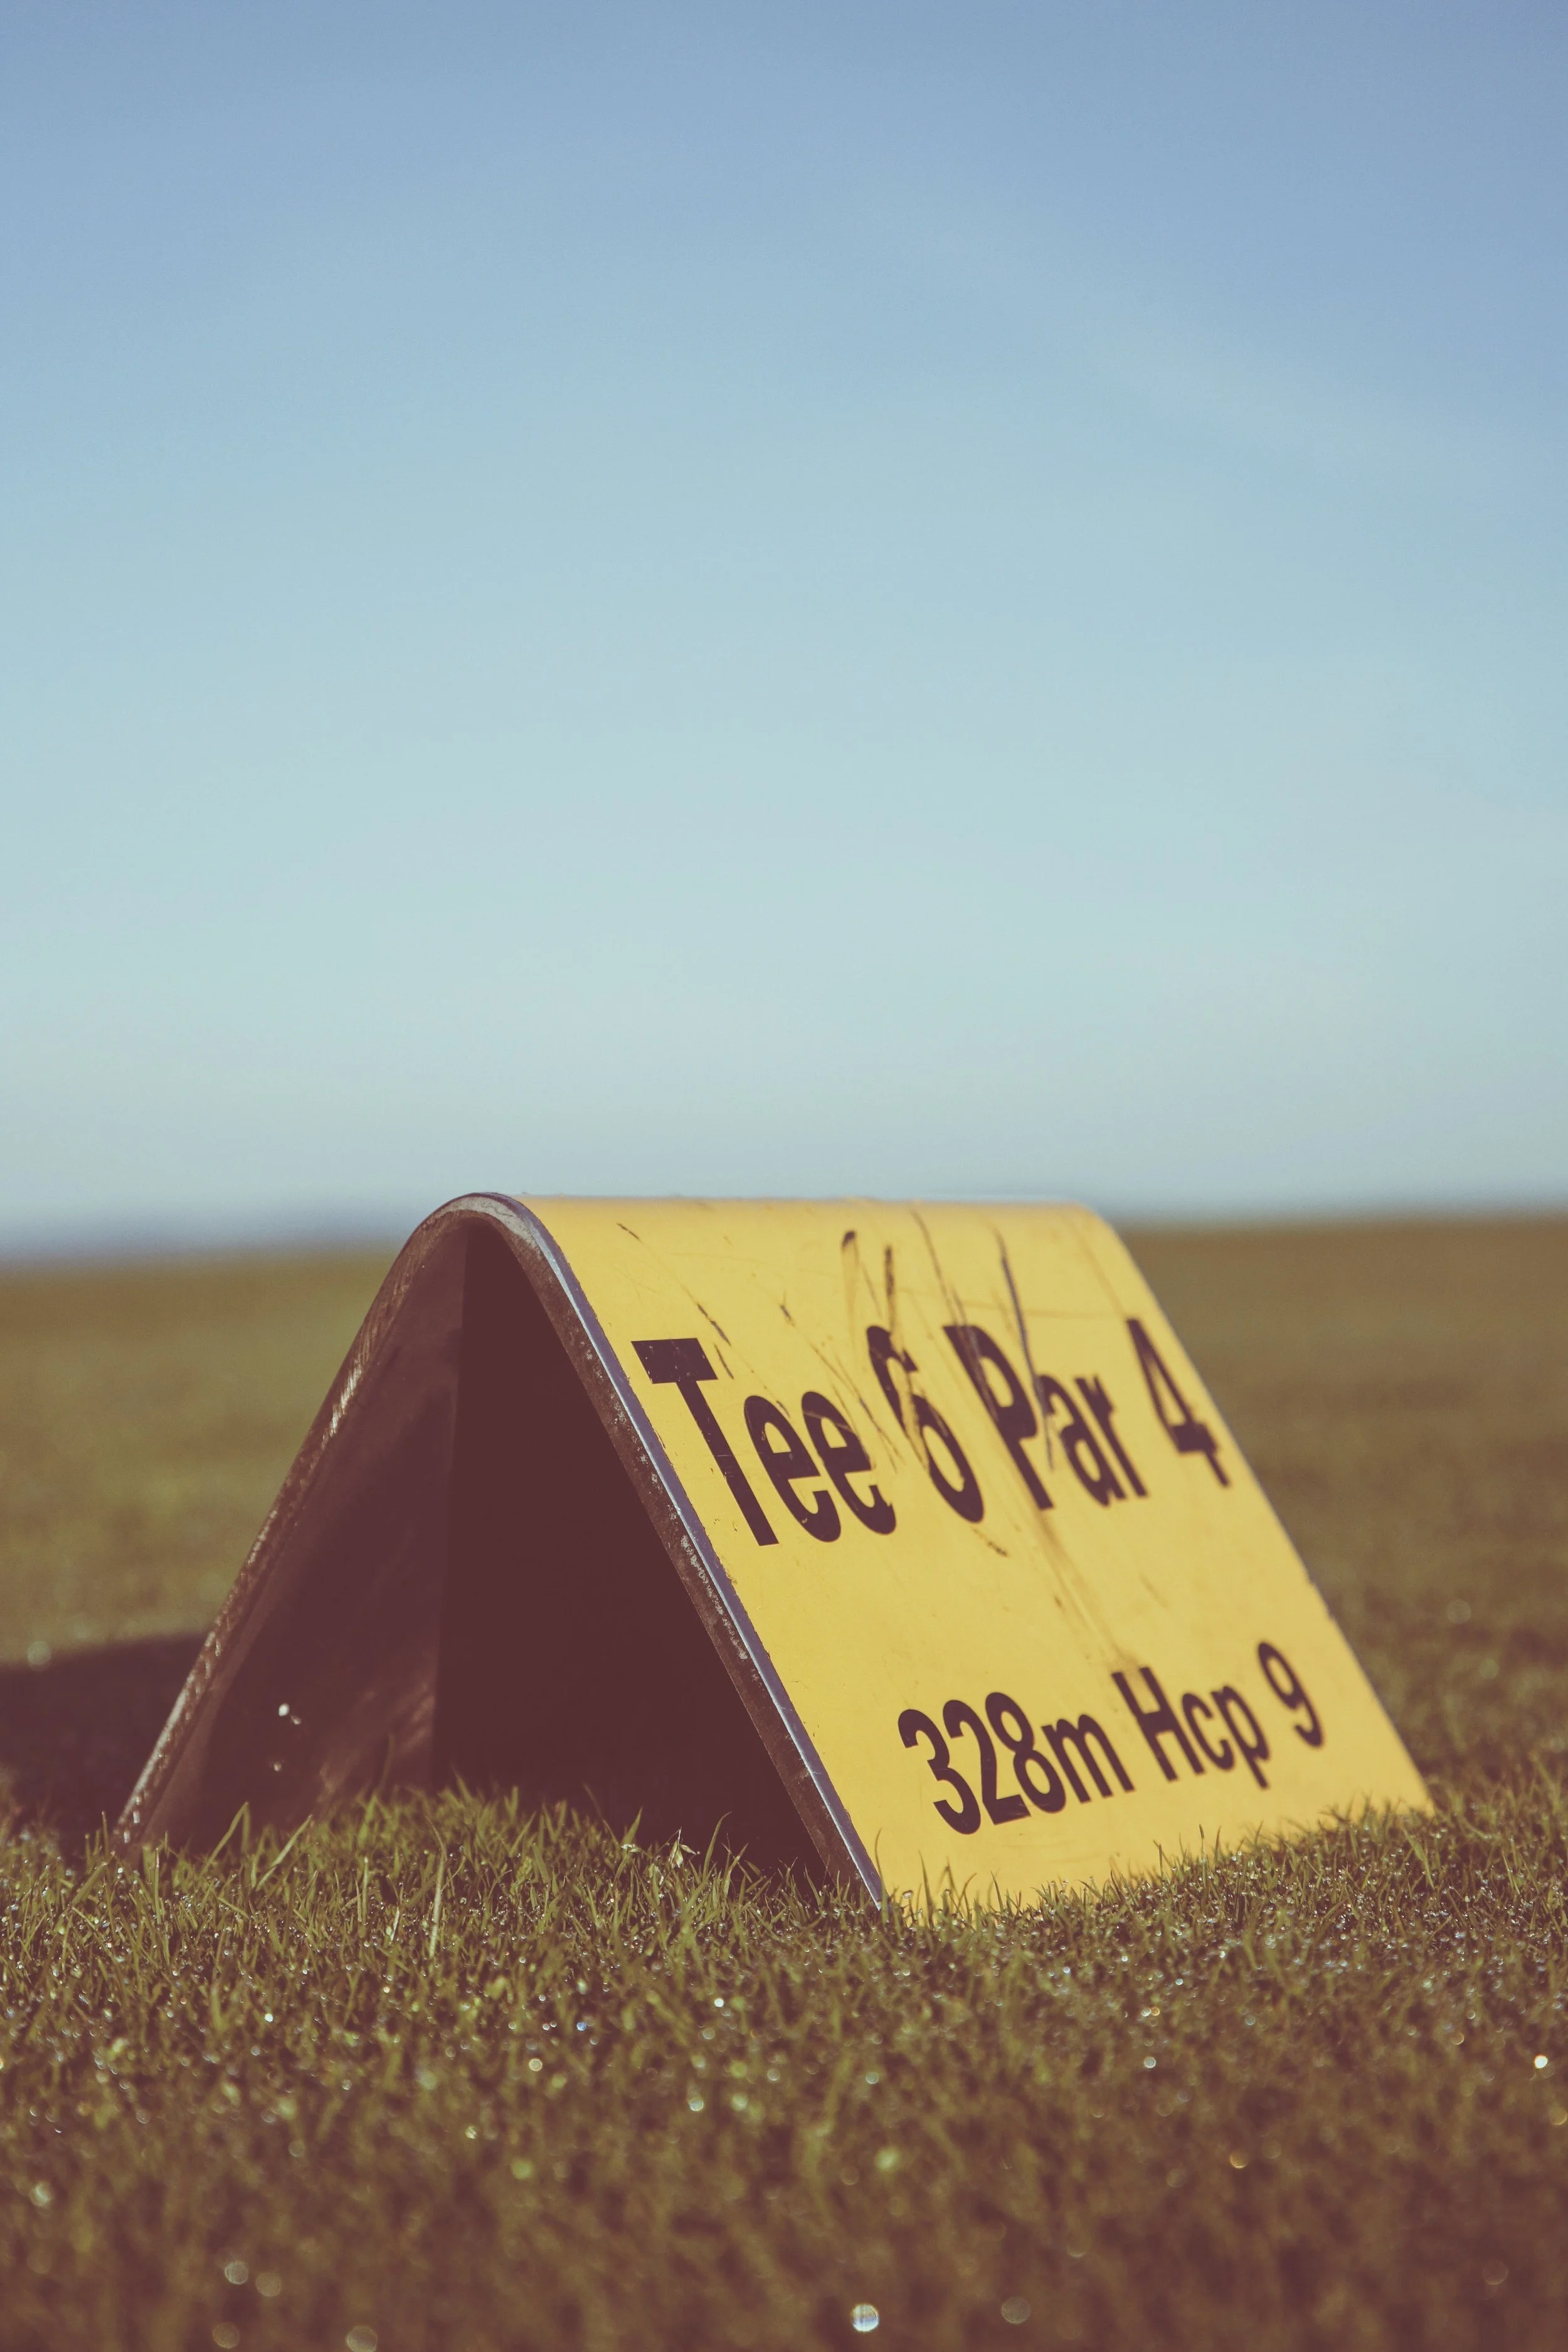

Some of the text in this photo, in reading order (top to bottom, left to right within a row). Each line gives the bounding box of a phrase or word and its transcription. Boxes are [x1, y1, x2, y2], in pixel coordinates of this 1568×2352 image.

[630, 1318, 1231, 1546] Tee 6 Par 4
[898, 1641, 1324, 1835] 328m Hcp 9
